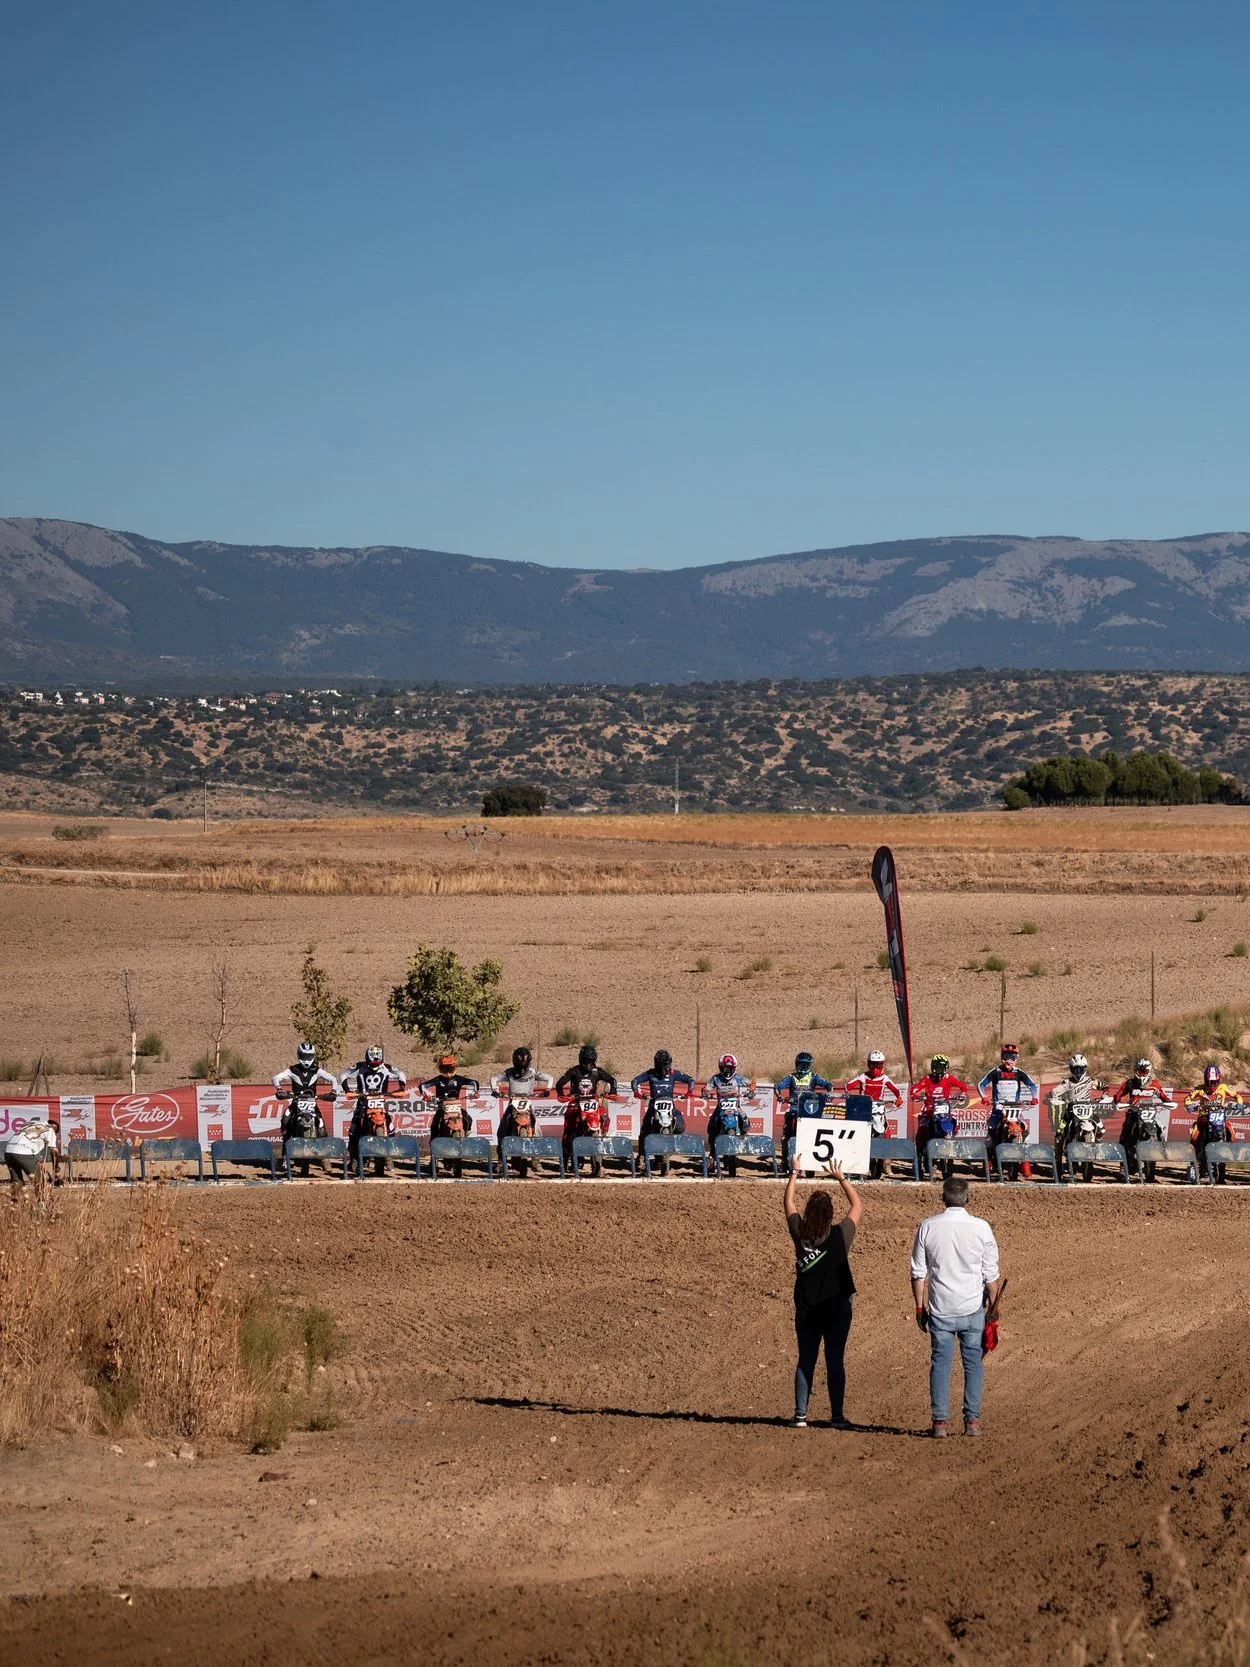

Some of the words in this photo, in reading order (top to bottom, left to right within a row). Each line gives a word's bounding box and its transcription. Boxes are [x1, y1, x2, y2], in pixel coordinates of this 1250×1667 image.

[298, 1101, 317, 1110] 272
[367, 1100, 385, 1109] 615
[518, 1101, 527, 1110] 9
[583, 1102, 597, 1111] 94
[808, 1103, 813, 1113] 1
[113, 1097, 177, 1129] Gates
[1076, 1108, 1090, 1117] 911
[1140, 1110, 1155, 1119] 27
[1209, 1112, 1225, 1122] 914
[803, 1248, 822, 1264] FOX
